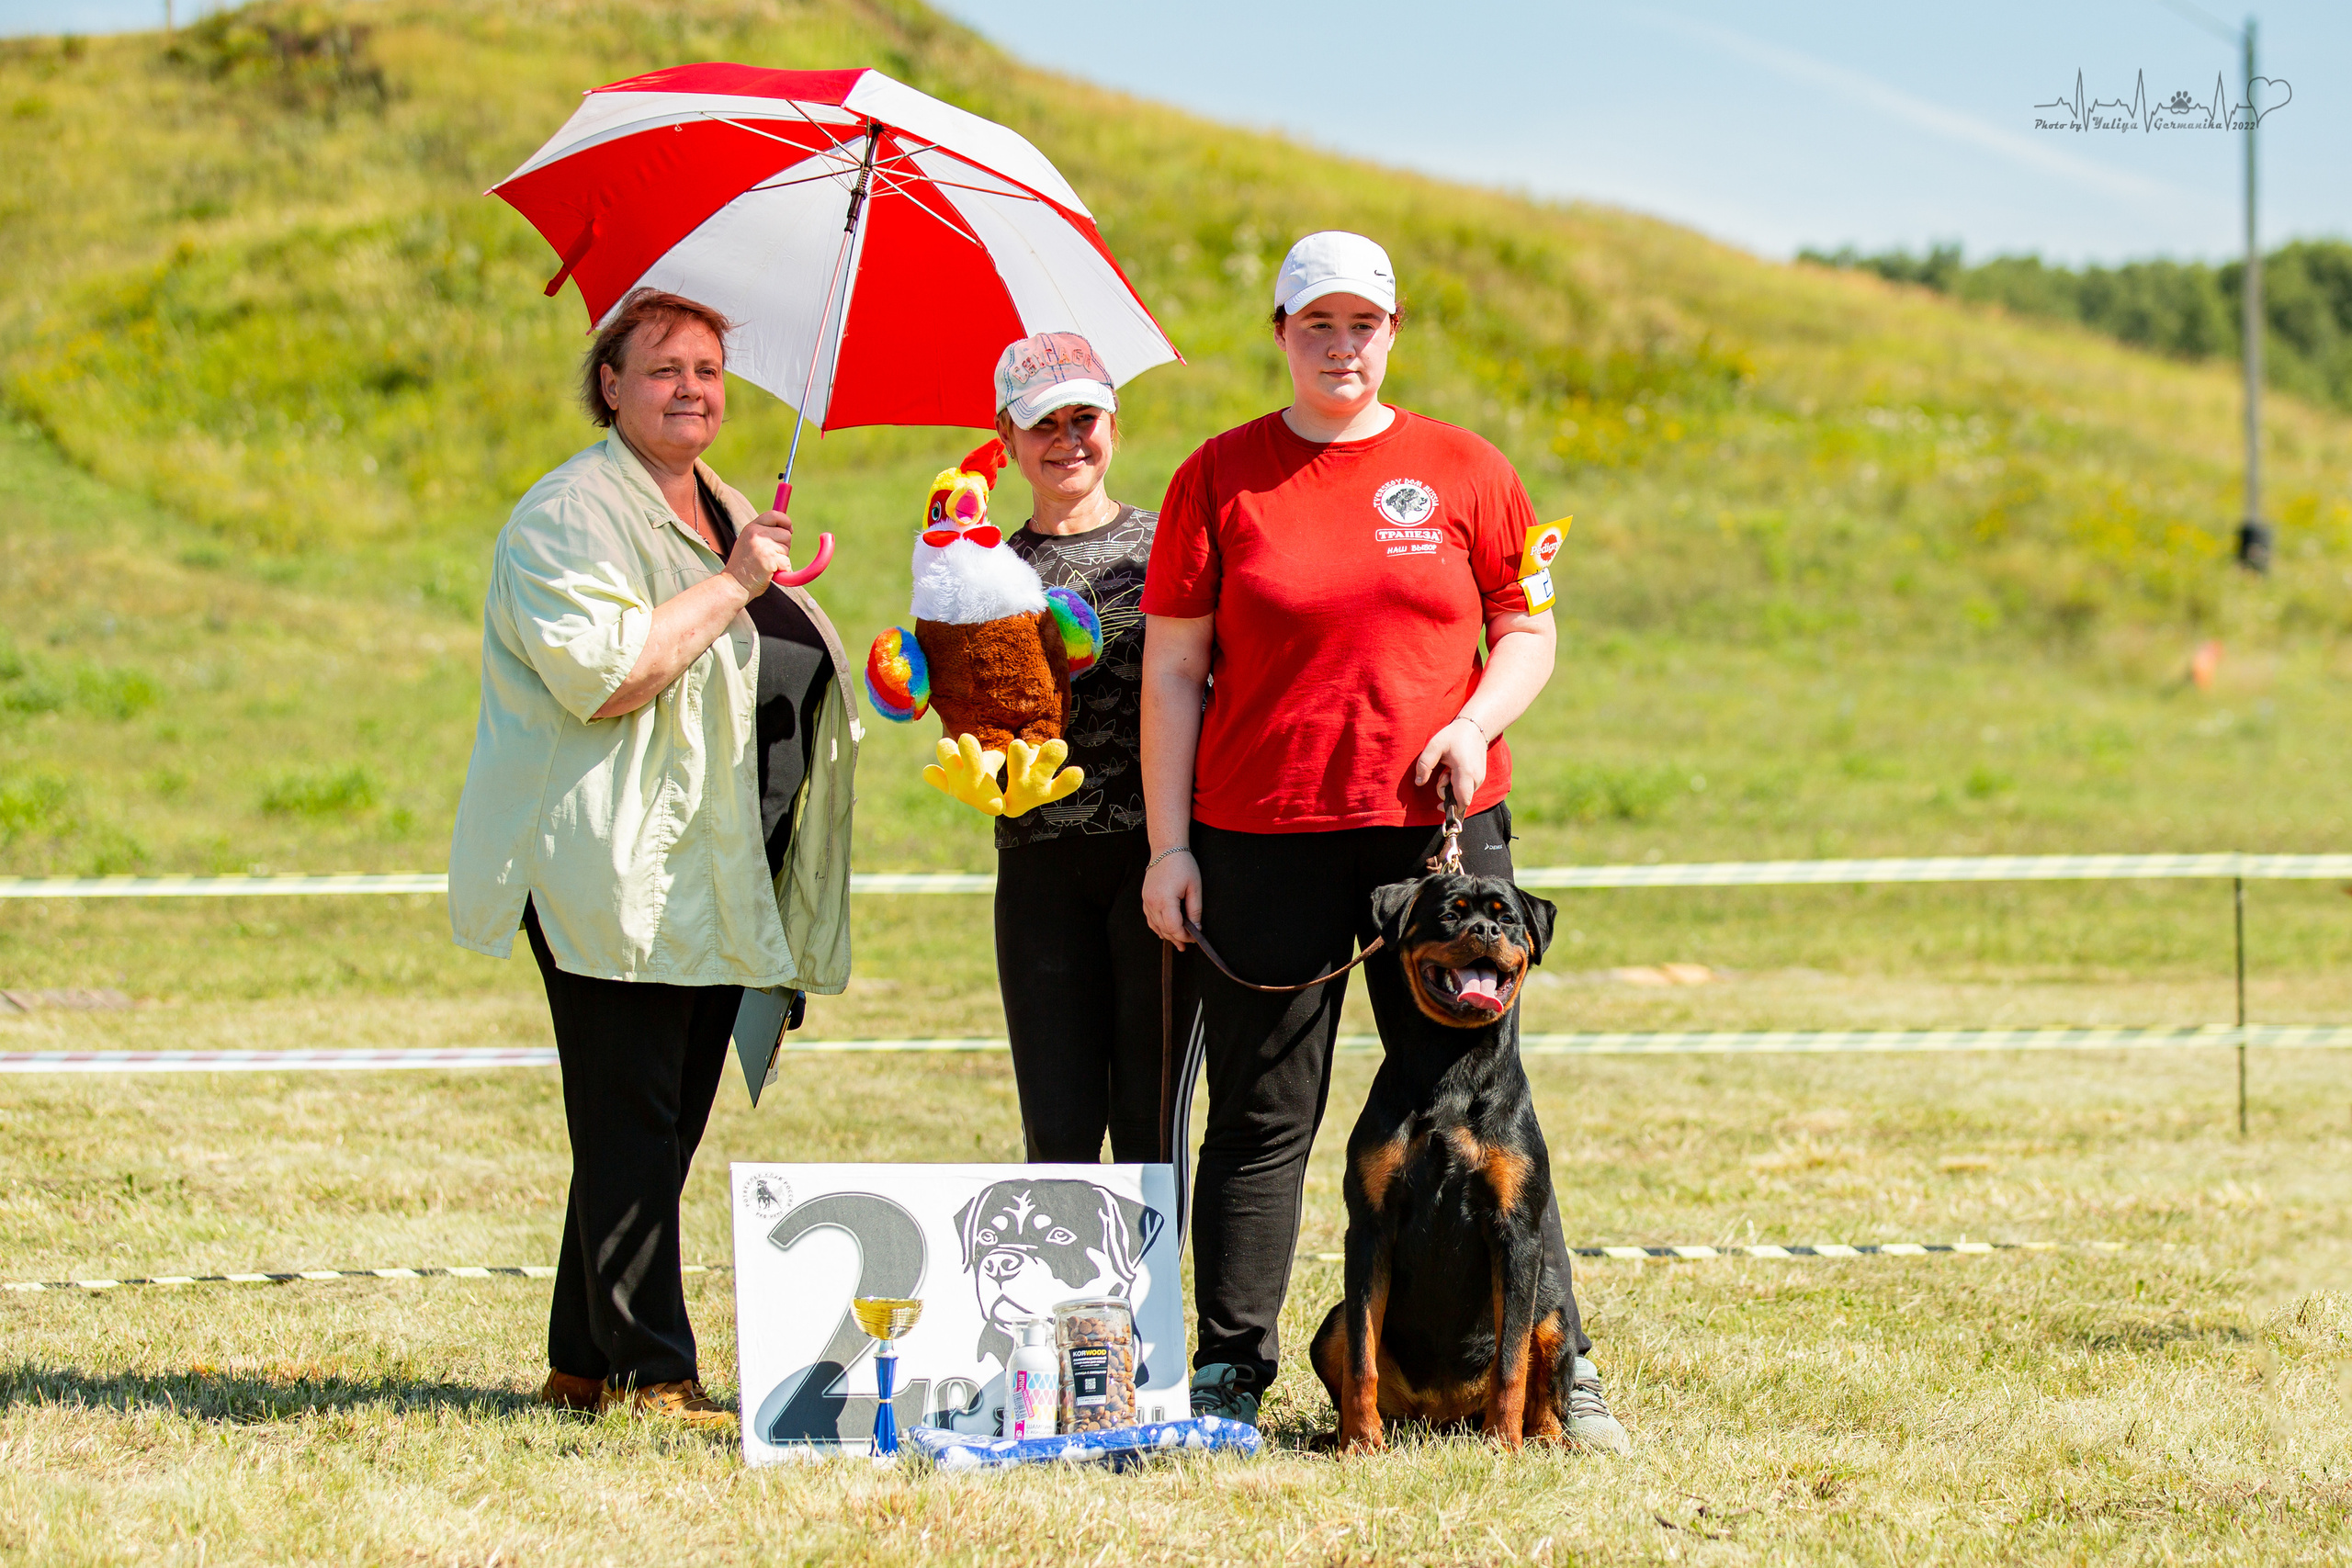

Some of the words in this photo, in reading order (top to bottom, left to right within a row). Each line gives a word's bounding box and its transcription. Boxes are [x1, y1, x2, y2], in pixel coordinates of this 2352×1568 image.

[1404, 478, 1423, 488] DOM
[1378, 530, 1441, 542] ТРАПЕЗА
[1386, 545, 1408, 555] НАШ
[1410, 544, 1437, 552] ВЫБОР
[768, 1191, 930, 1443] 2
[1072, 1348, 1107, 1357] KORWOOD
